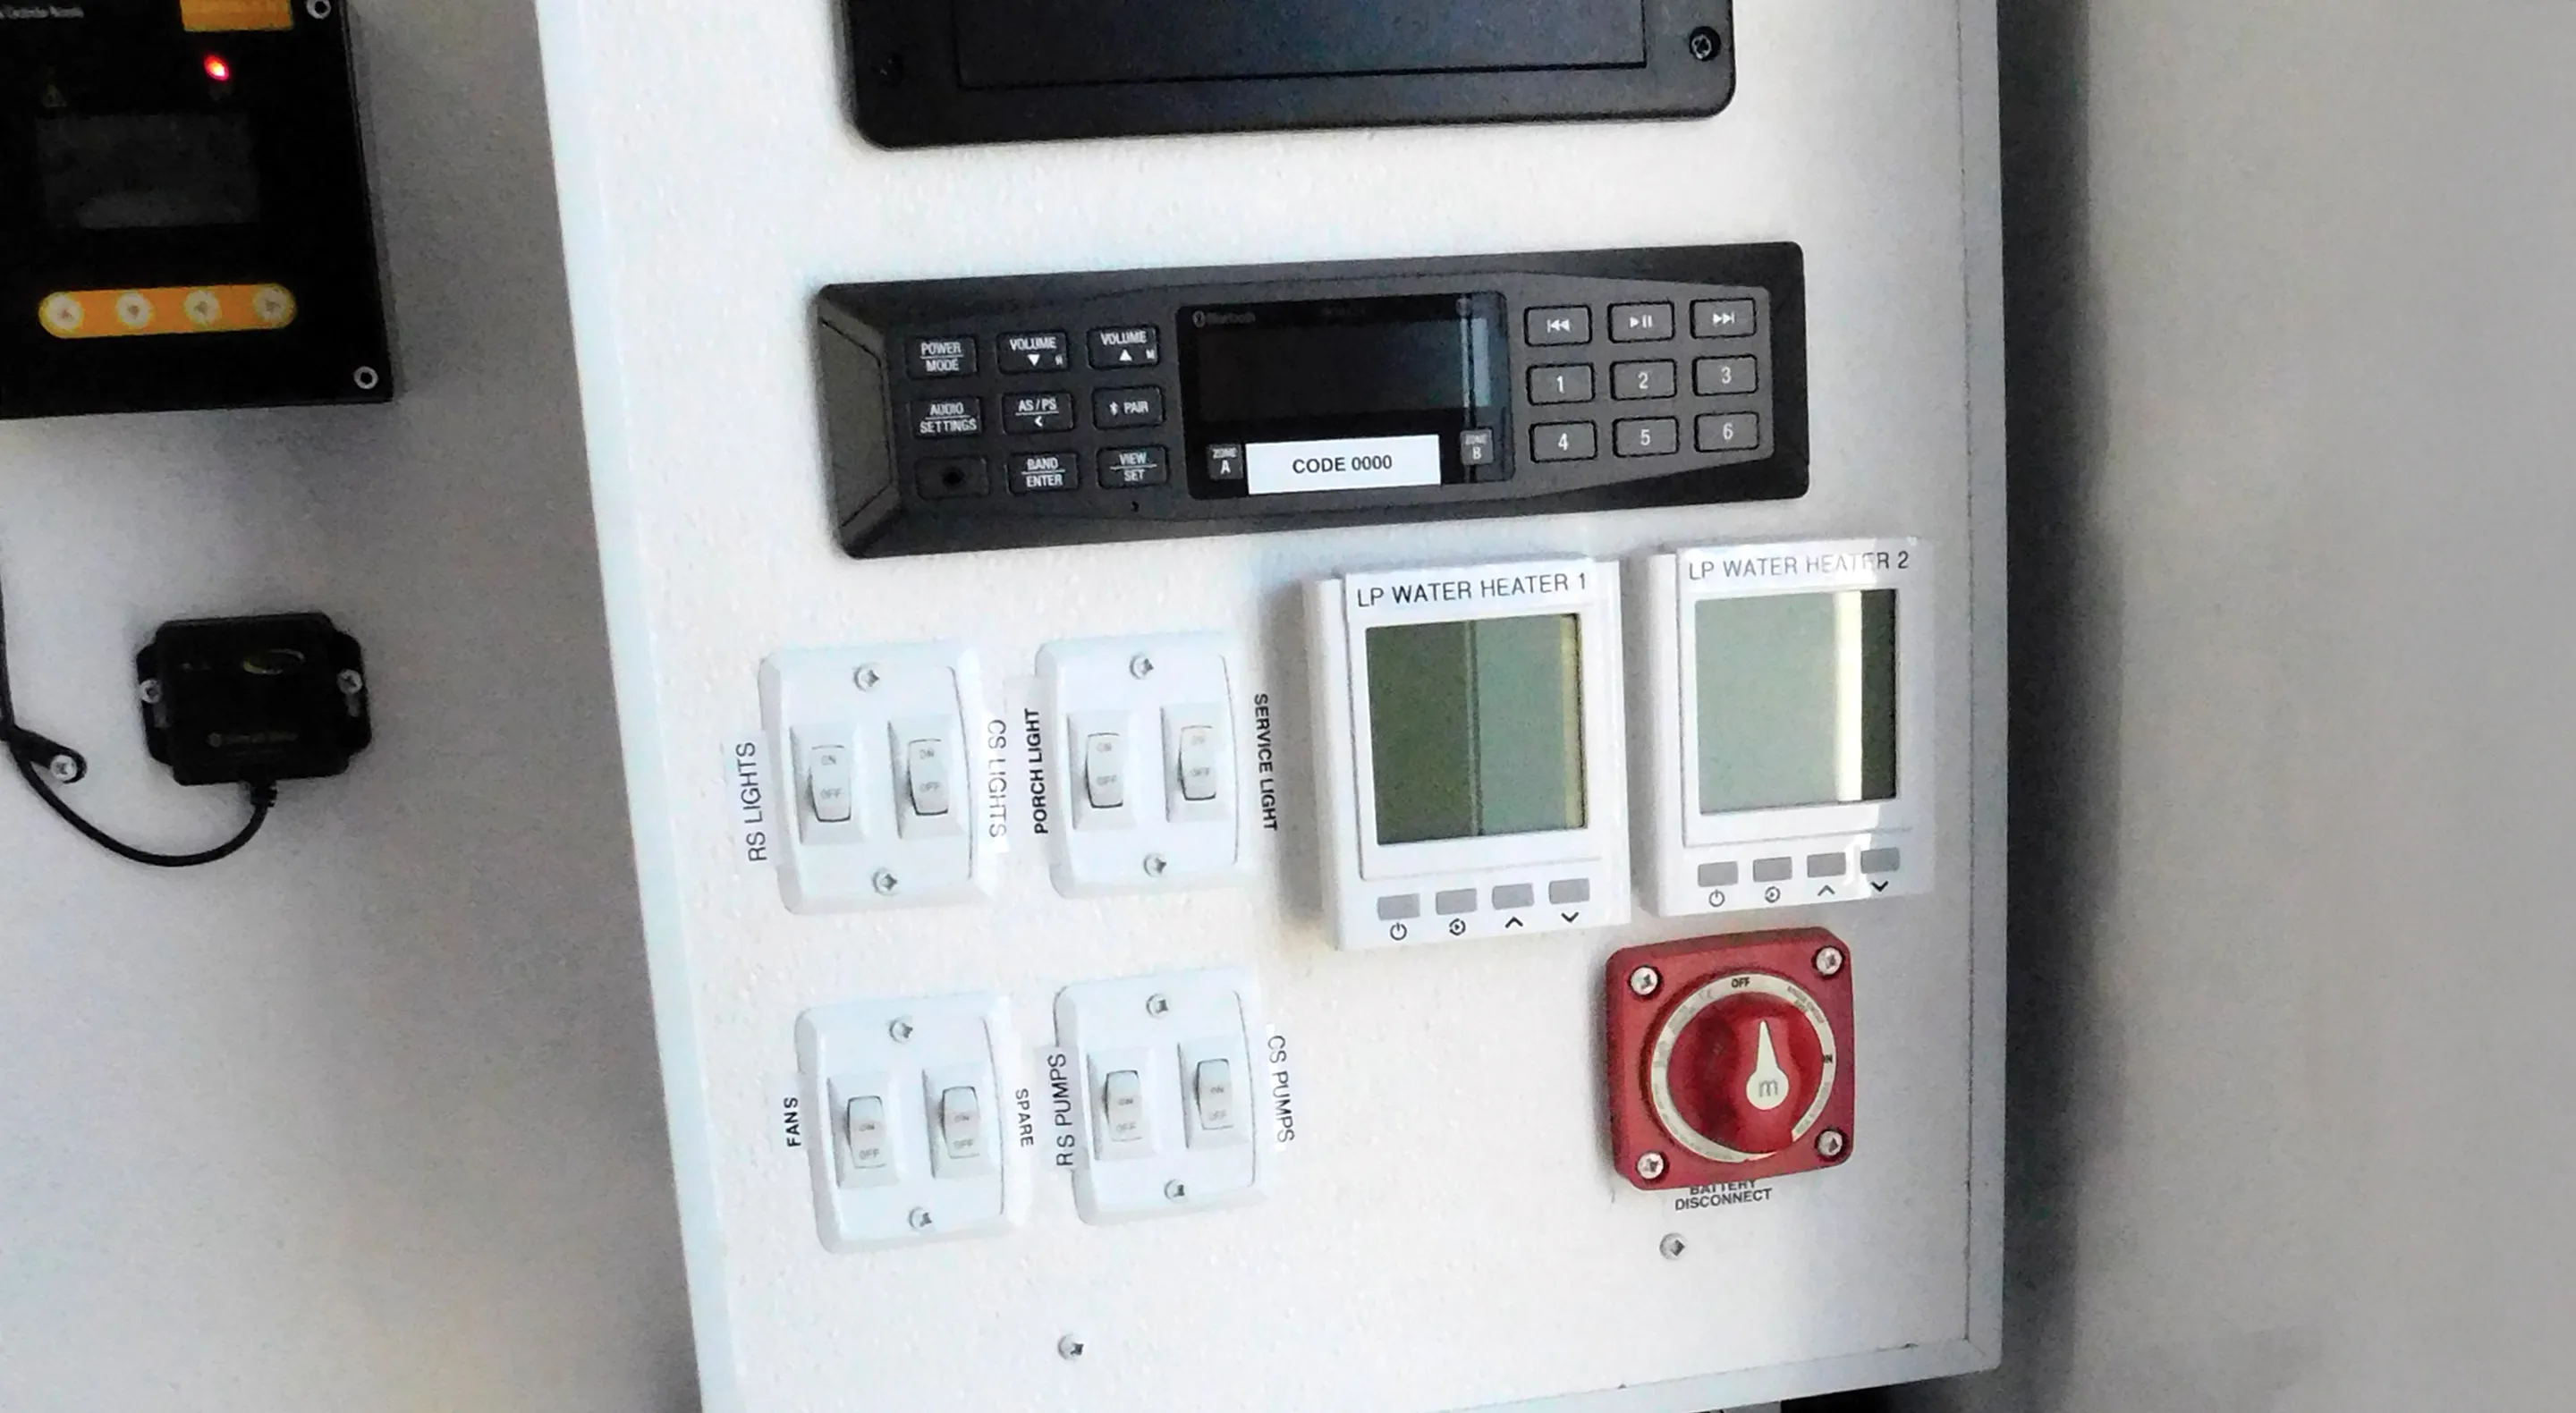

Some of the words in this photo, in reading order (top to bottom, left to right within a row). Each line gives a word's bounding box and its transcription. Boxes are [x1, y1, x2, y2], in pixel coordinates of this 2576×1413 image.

[1009, 337, 1057, 351] VOLUME
[1100, 331, 1148, 345] VOLUME
[920, 342, 962, 355] POWER
[926, 359, 960, 372] MODE
[1556, 376, 1564, 393] 1
[1638, 372, 1649, 390] 2
[1721, 367, 1732, 385] 3
[929, 402, 964, 416] AUDIO
[1123, 401, 1149, 413] PAIR
[919, 419, 978, 433] SETTINGS
[1723, 423, 1733, 440] 6
[1557, 433, 1569, 451] 4
[1640, 429, 1651, 446] 5
[1119, 453, 1148, 465] VIEW
[1472, 446, 1482, 461] B
[1027, 457, 1058, 470] BAND
[1220, 460, 1232, 475] A
[1292, 456, 1347, 474] CODE
[1352, 454, 1393, 471] 0000
[1027, 473, 1063, 487] ENTER
[1123, 469, 1145, 481] SET
[1688, 561, 1715, 581] LP
[1724, 556, 1798, 578] WATER
[1806, 551, 1890, 574] HEATER
[1897, 550, 1911, 570] 2
[1357, 587, 1385, 607] LP
[1392, 580, 1473, 605] WATER
[1480, 572, 1570, 598] HEATER
[1578, 572, 1586, 590] 1
[987, 719, 1007, 749] CS
[1023, 707, 1046, 764] LIGHT
[1253, 692, 1274, 774] SERVICE
[735, 741, 764, 825] LIGHTS
[987, 758, 1008, 839] LIGHTS
[1029, 768, 1049, 834] PORCH
[1258, 779, 1278, 832] LIGHT
[745, 831, 767, 862] RS
[1731, 977, 1751, 990] OFF
[1267, 1035, 1288, 1064] CS
[1046, 1053, 1072, 1127] PUMPS
[1271, 1070, 1296, 1144] PUMPS
[783, 1096, 803, 1148] FANS
[1014, 1087, 1035, 1147] SPARE
[953, 1138, 975, 1150] OFF
[859, 1148, 881, 1160] OFF
[1690, 1179, 1756, 1196] BATTERY
[1674, 1188, 1773, 1211] DISCONNECT
